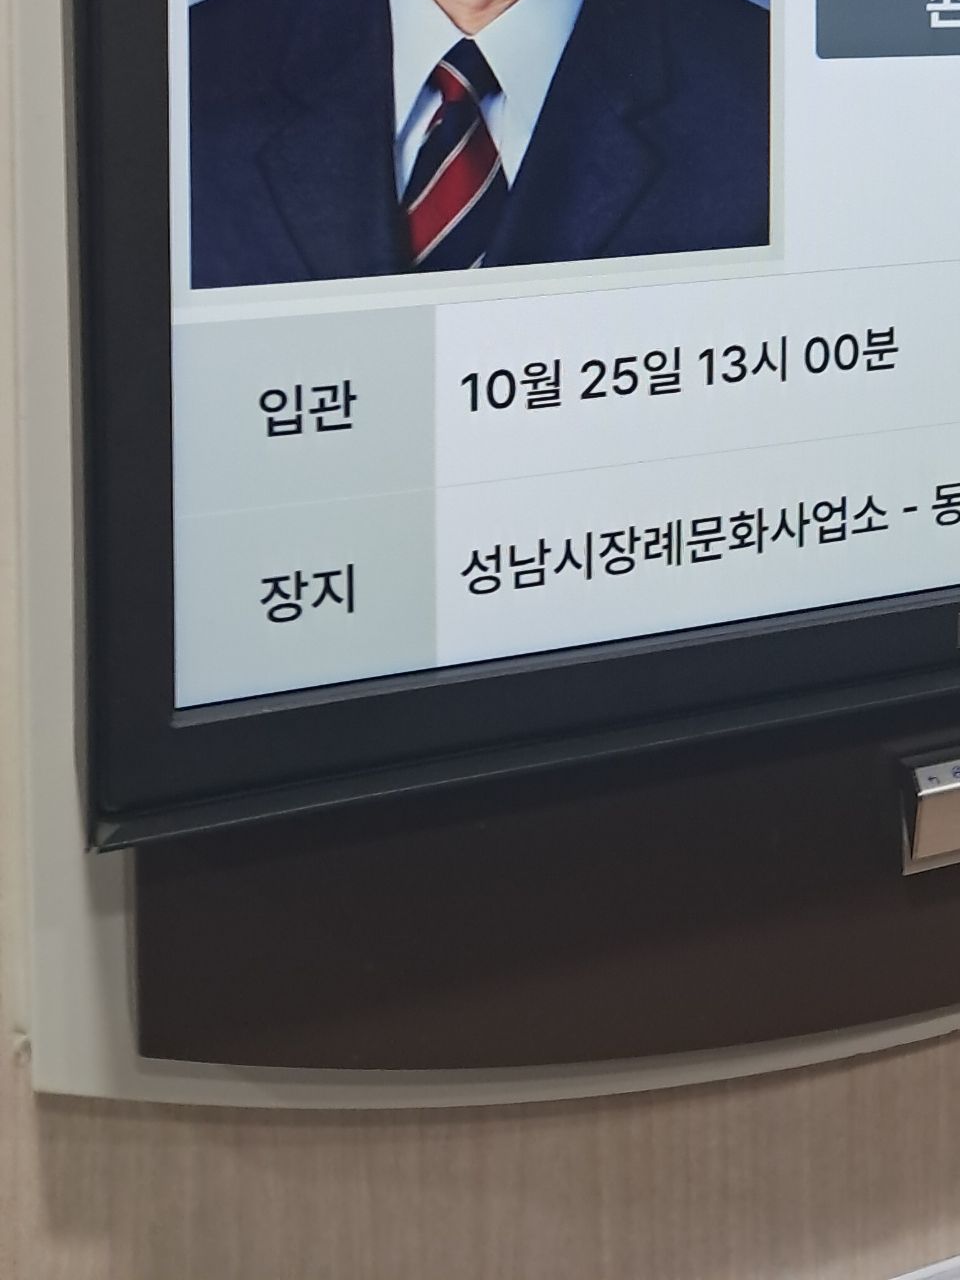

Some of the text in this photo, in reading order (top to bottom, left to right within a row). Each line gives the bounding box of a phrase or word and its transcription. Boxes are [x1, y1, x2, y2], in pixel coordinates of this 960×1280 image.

[461, 326, 899, 412] 10월 25일 13시 00분
[258, 379, 358, 438] 입관
[460, 494, 890, 596] 성남시장례문화사업소
[260, 563, 355, 624] 장지
